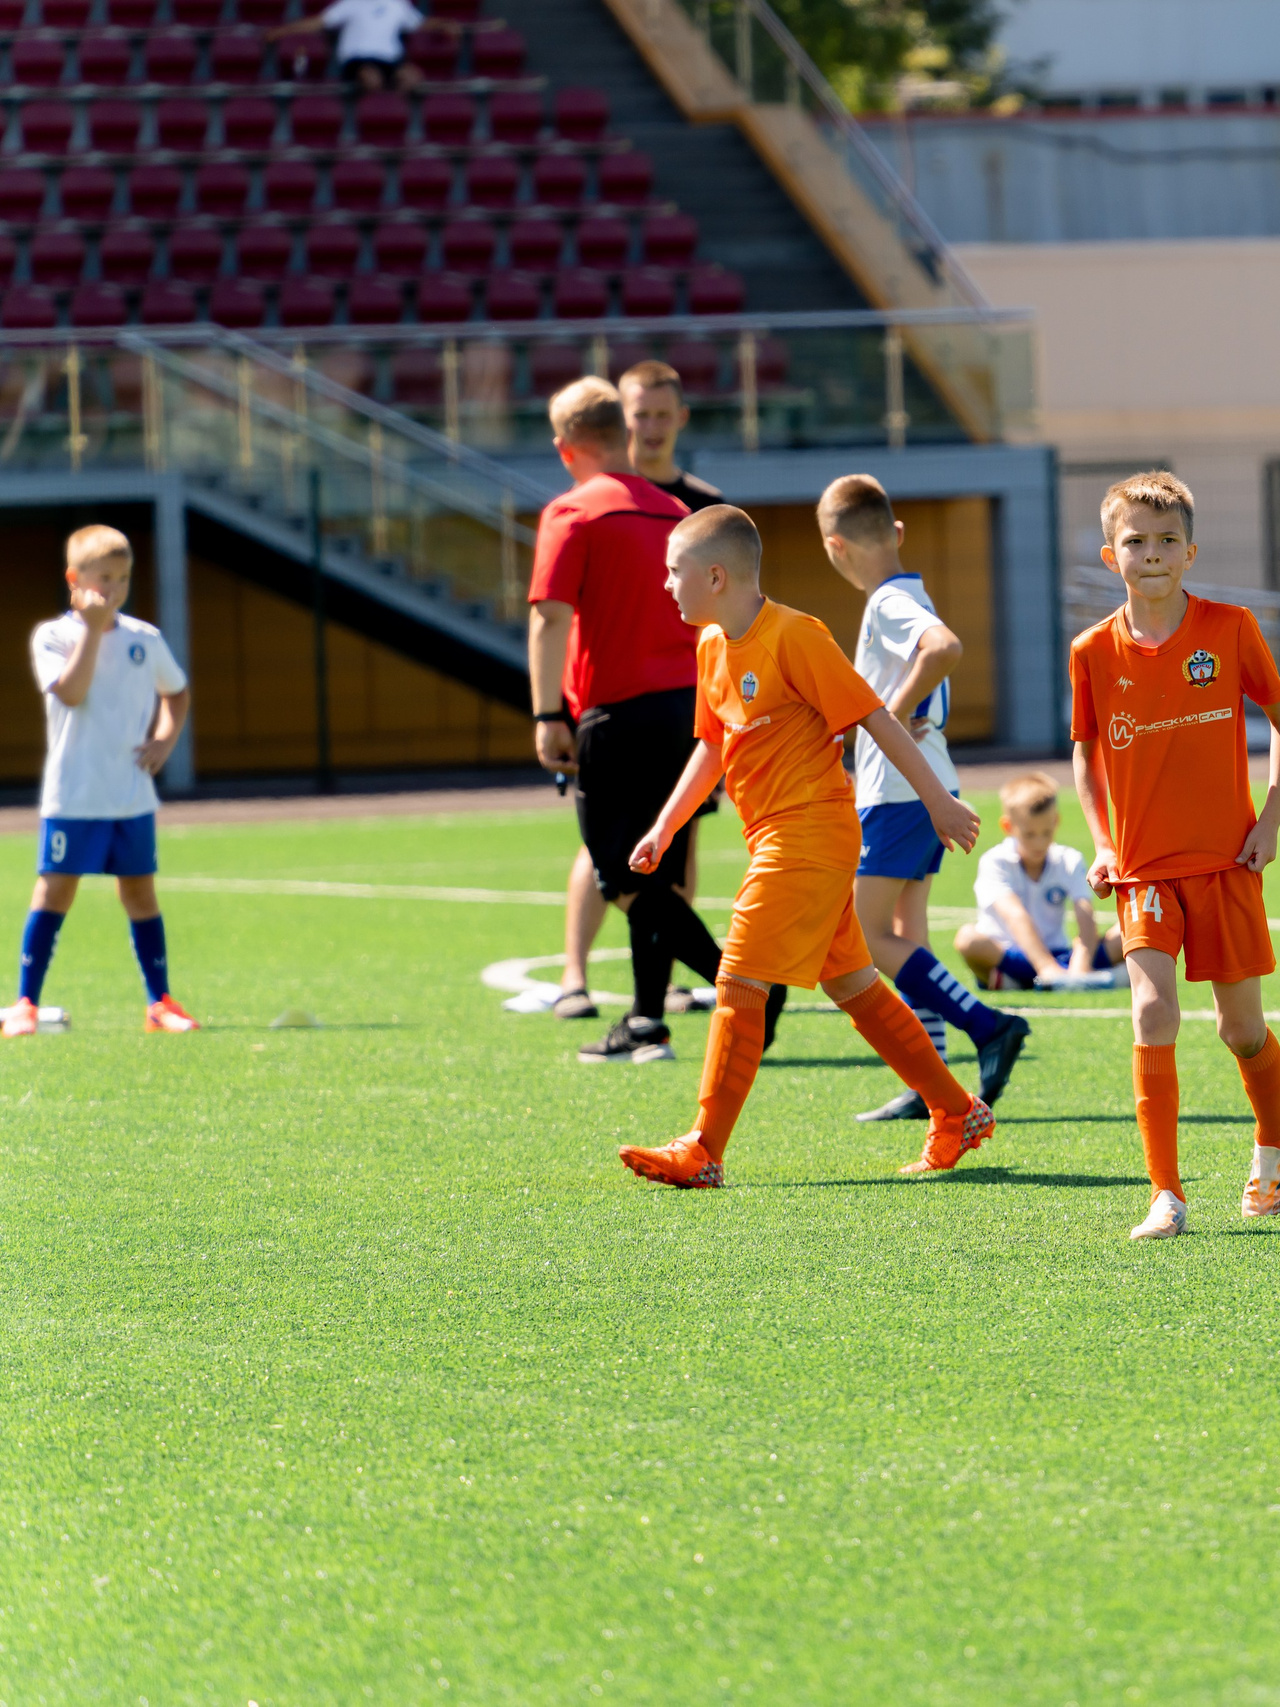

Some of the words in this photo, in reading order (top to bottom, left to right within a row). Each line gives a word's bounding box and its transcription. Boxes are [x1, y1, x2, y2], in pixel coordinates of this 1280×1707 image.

[1135, 714, 1198, 732] РУССКИЙ
[1199, 708, 1232, 722] САПР
[51, 830, 67, 864] 9
[1128, 885, 1163, 923] 14
